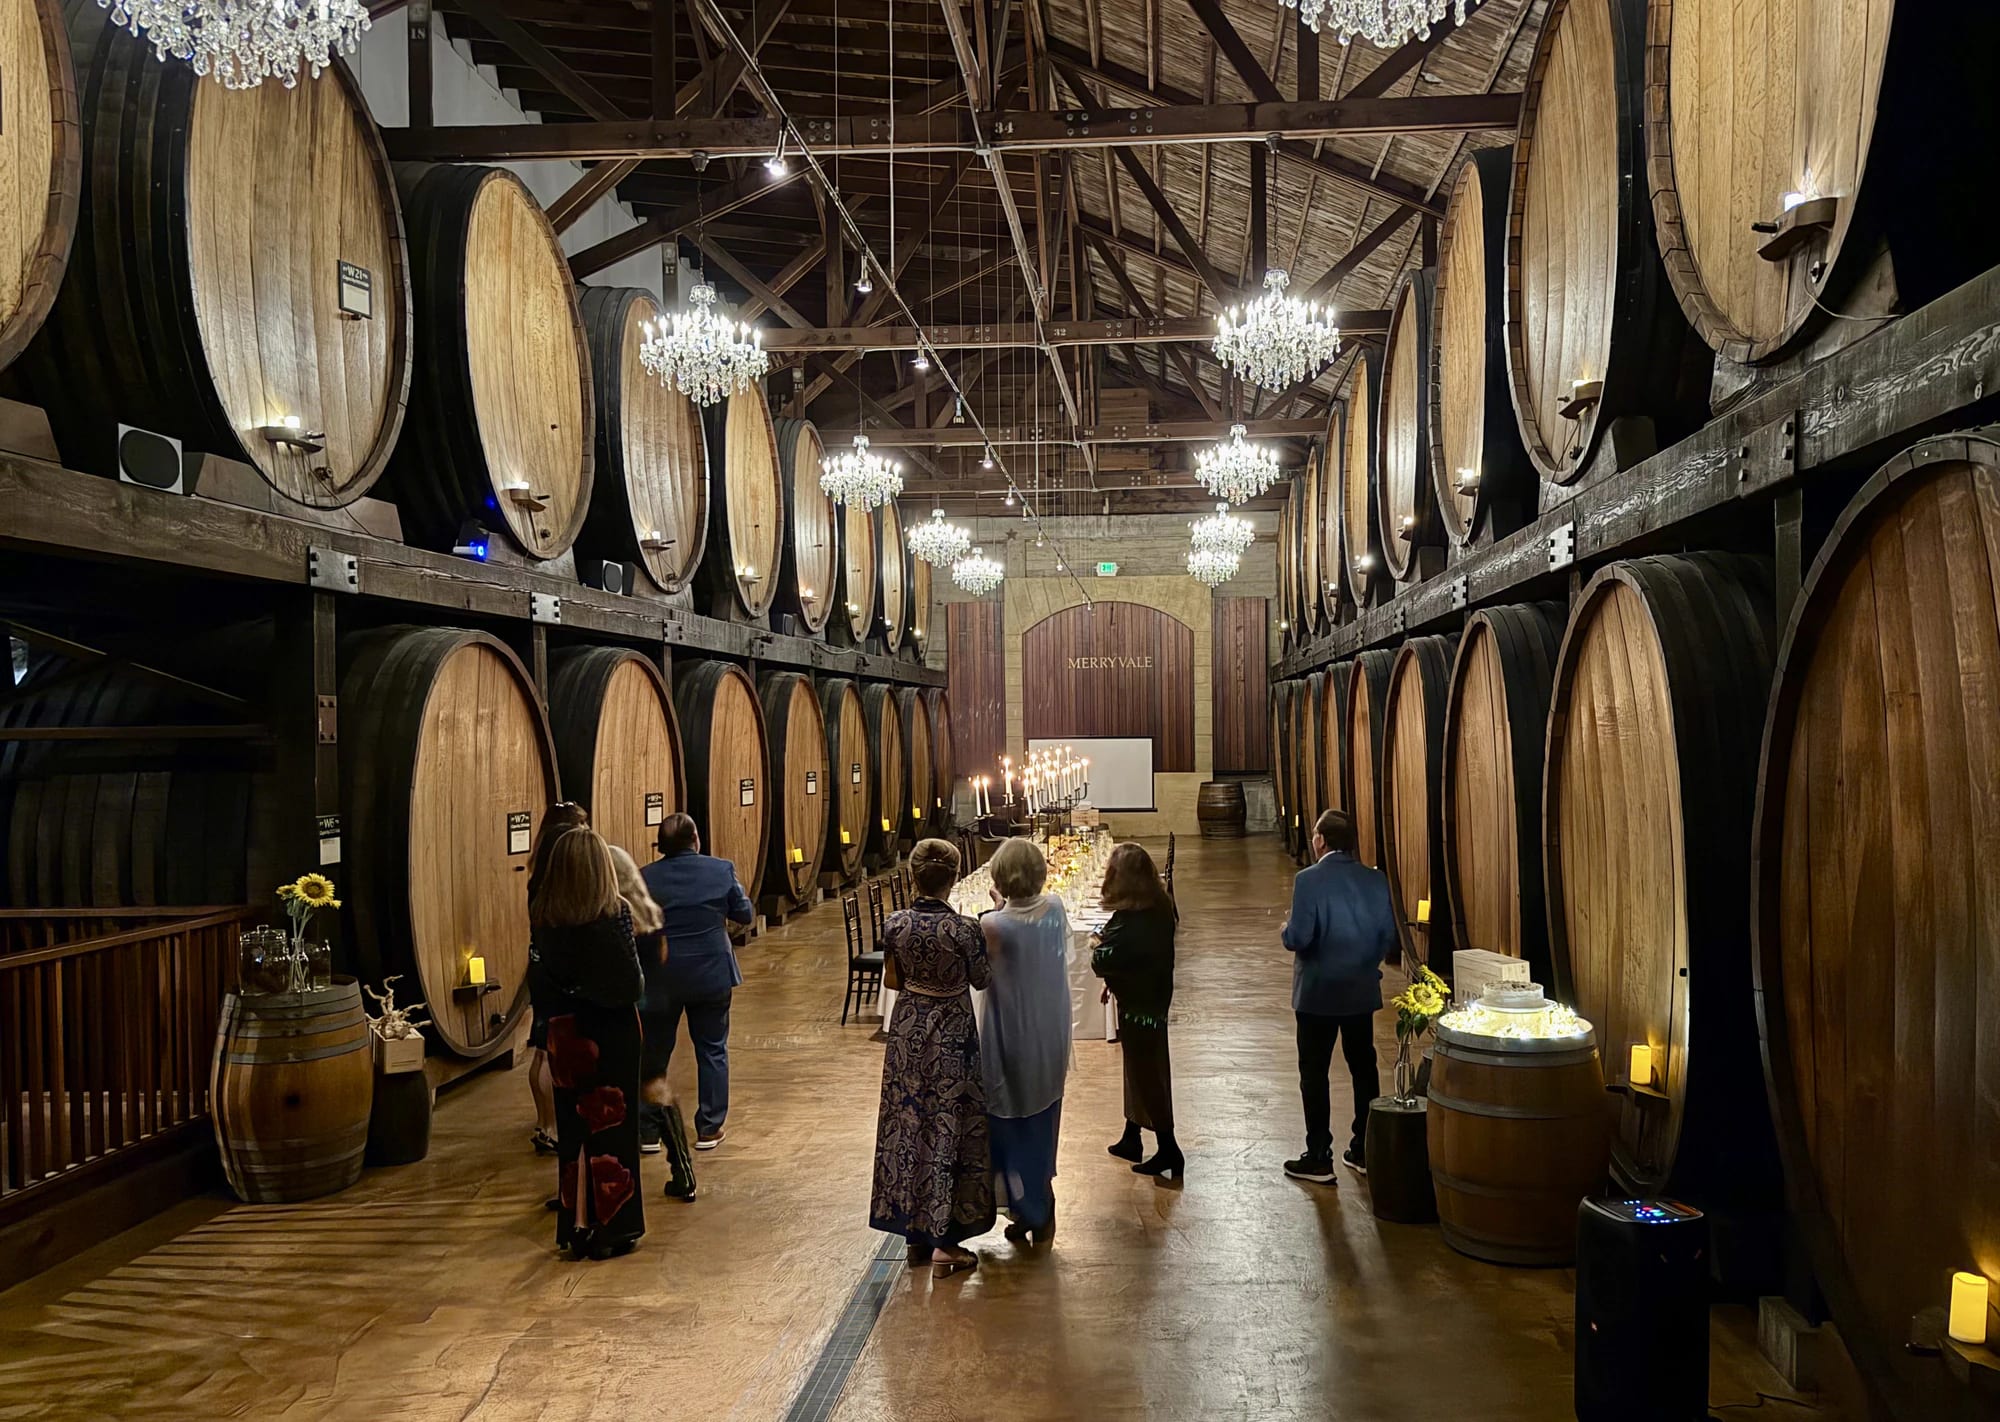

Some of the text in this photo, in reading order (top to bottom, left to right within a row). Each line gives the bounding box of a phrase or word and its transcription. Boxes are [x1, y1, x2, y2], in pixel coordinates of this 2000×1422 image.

[994, 121, 1014, 134] 34
[1053, 328, 1067, 336] 32
[1068, 656, 1153, 670] MERRYVALE
